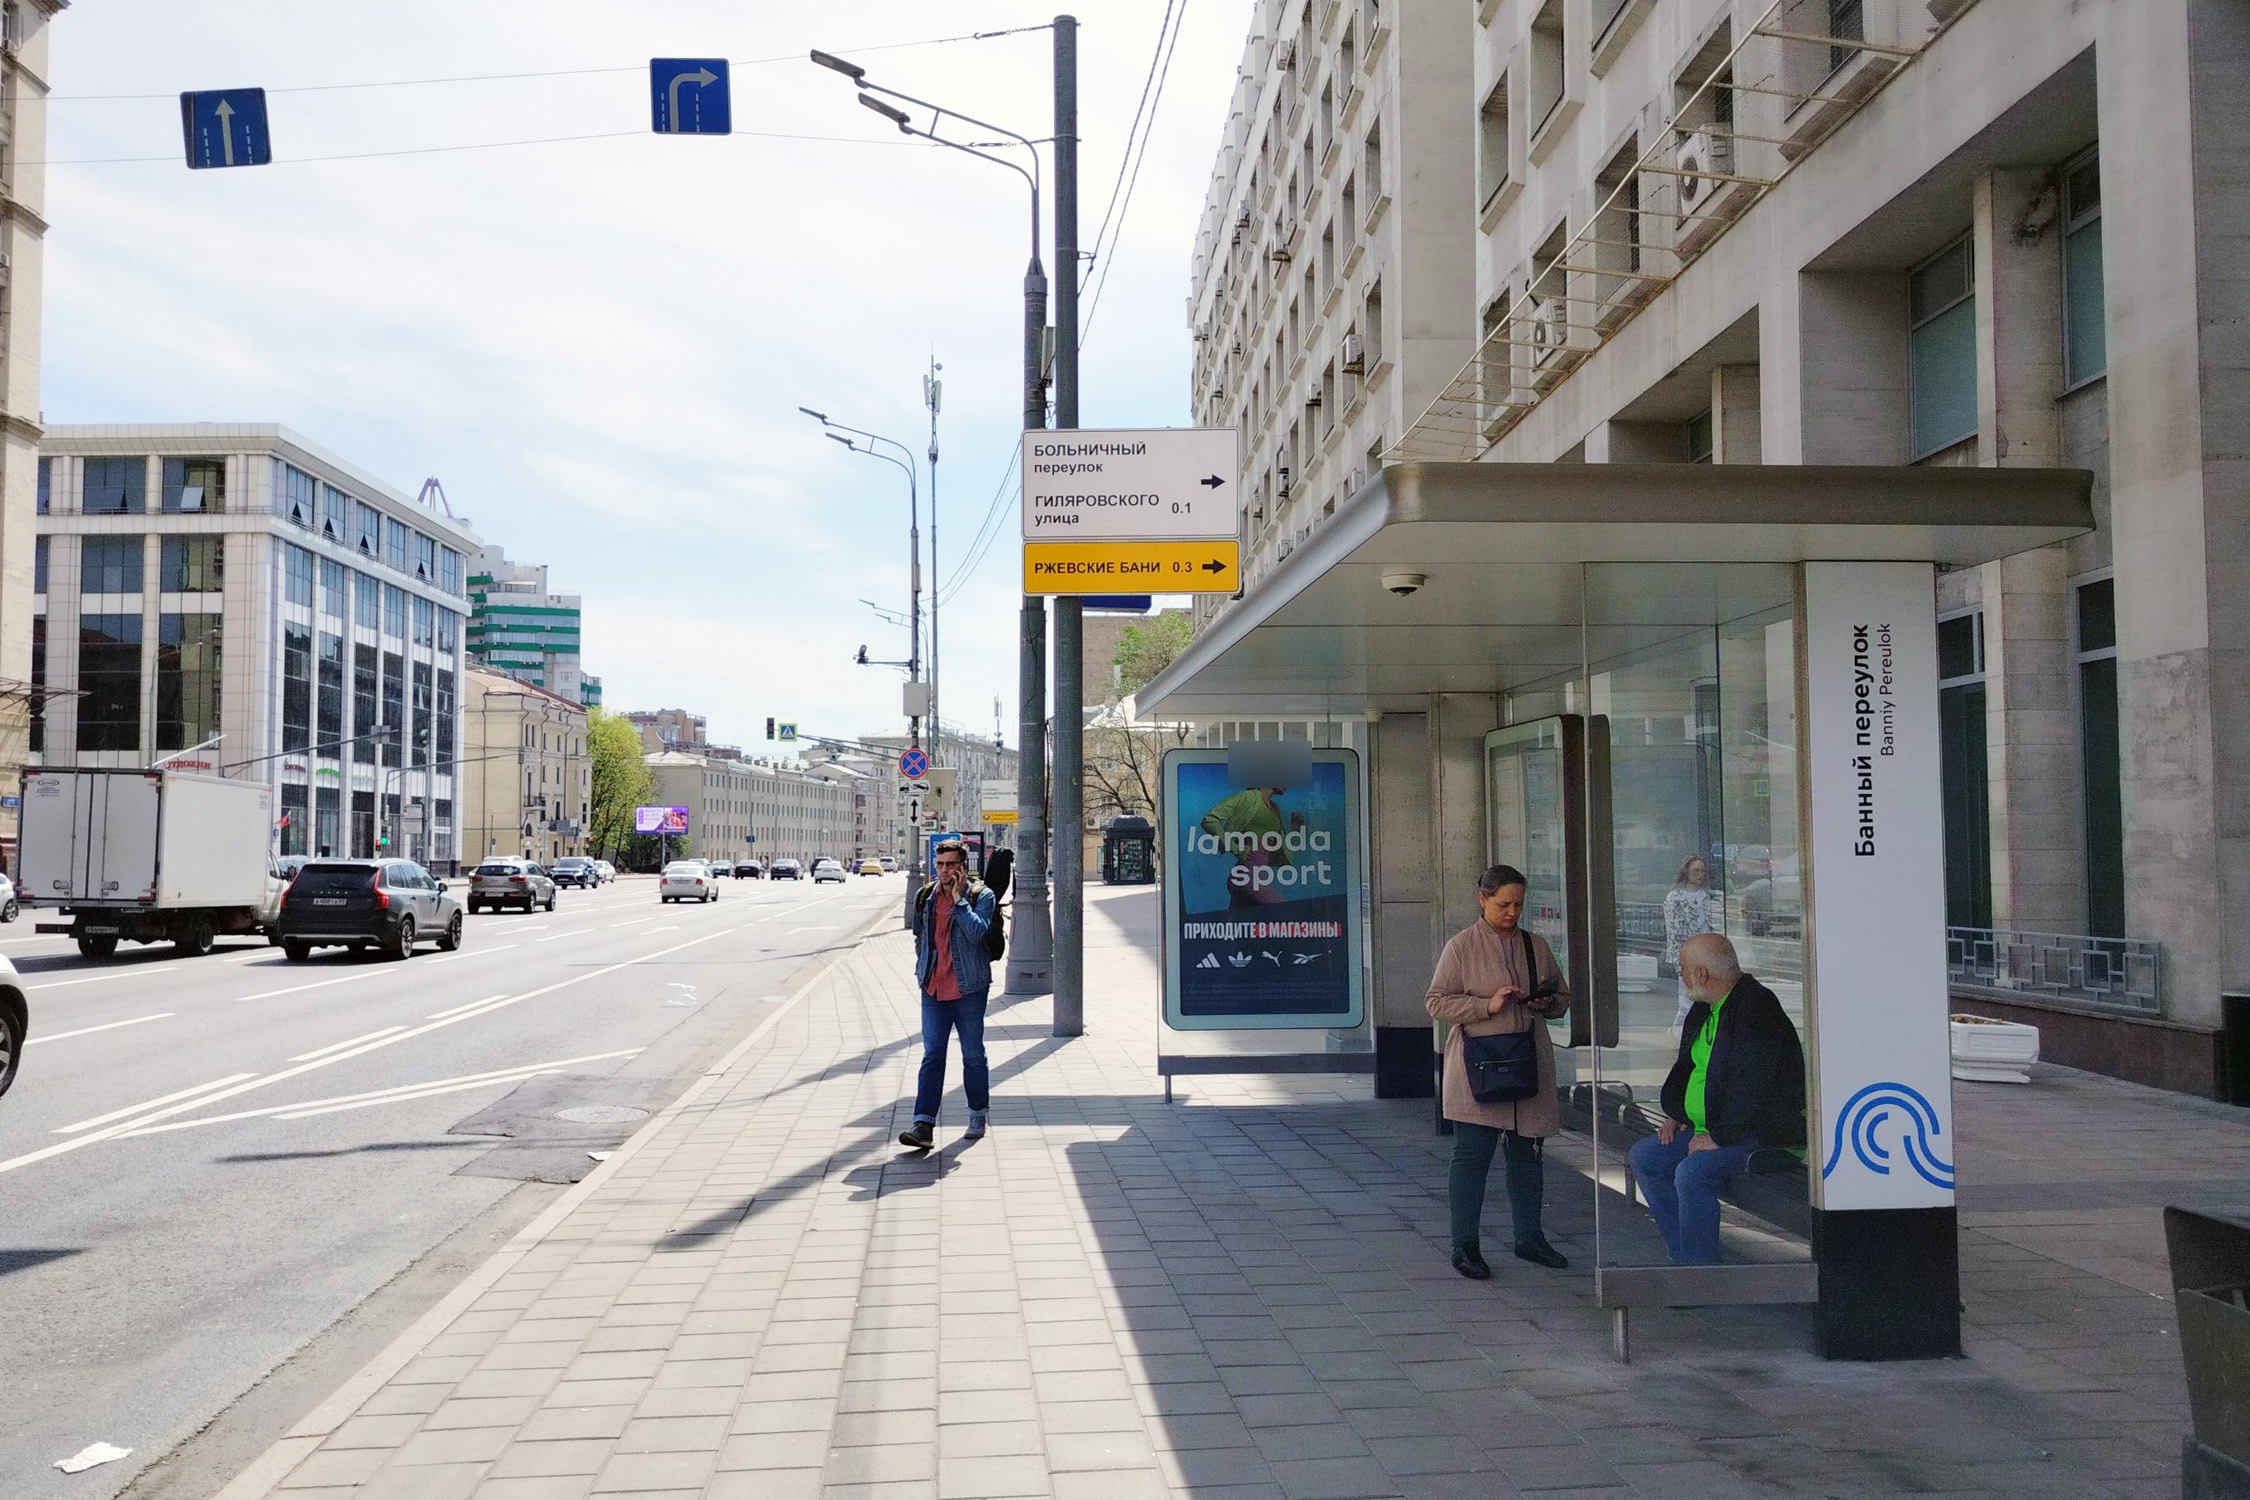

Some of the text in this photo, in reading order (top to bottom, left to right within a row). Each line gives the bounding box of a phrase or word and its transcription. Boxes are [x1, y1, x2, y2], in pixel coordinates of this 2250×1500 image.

[1034, 440, 1146, 457] БОЛЬНИЧНЫЙ
[1034, 462, 1103, 475] переулок
[1035, 494, 1160, 508] ГИЛЯРОВСКОГО
[1171, 502, 1192, 515] 0.1
[1034, 513, 1080, 527] улица
[1034, 561, 1193, 574] РЖЕВСКИЕ БАНИ 0.3
[1876, 623, 1896, 757] Banniy Pereulok
[1852, 624, 1875, 857] Банный переулок
[1187, 825, 1332, 855] lamoda
[1230, 860, 1333, 891] sport
[1184, 921, 1339, 941] ПРИХОДИТЕ В МАГАЗИНЫ
